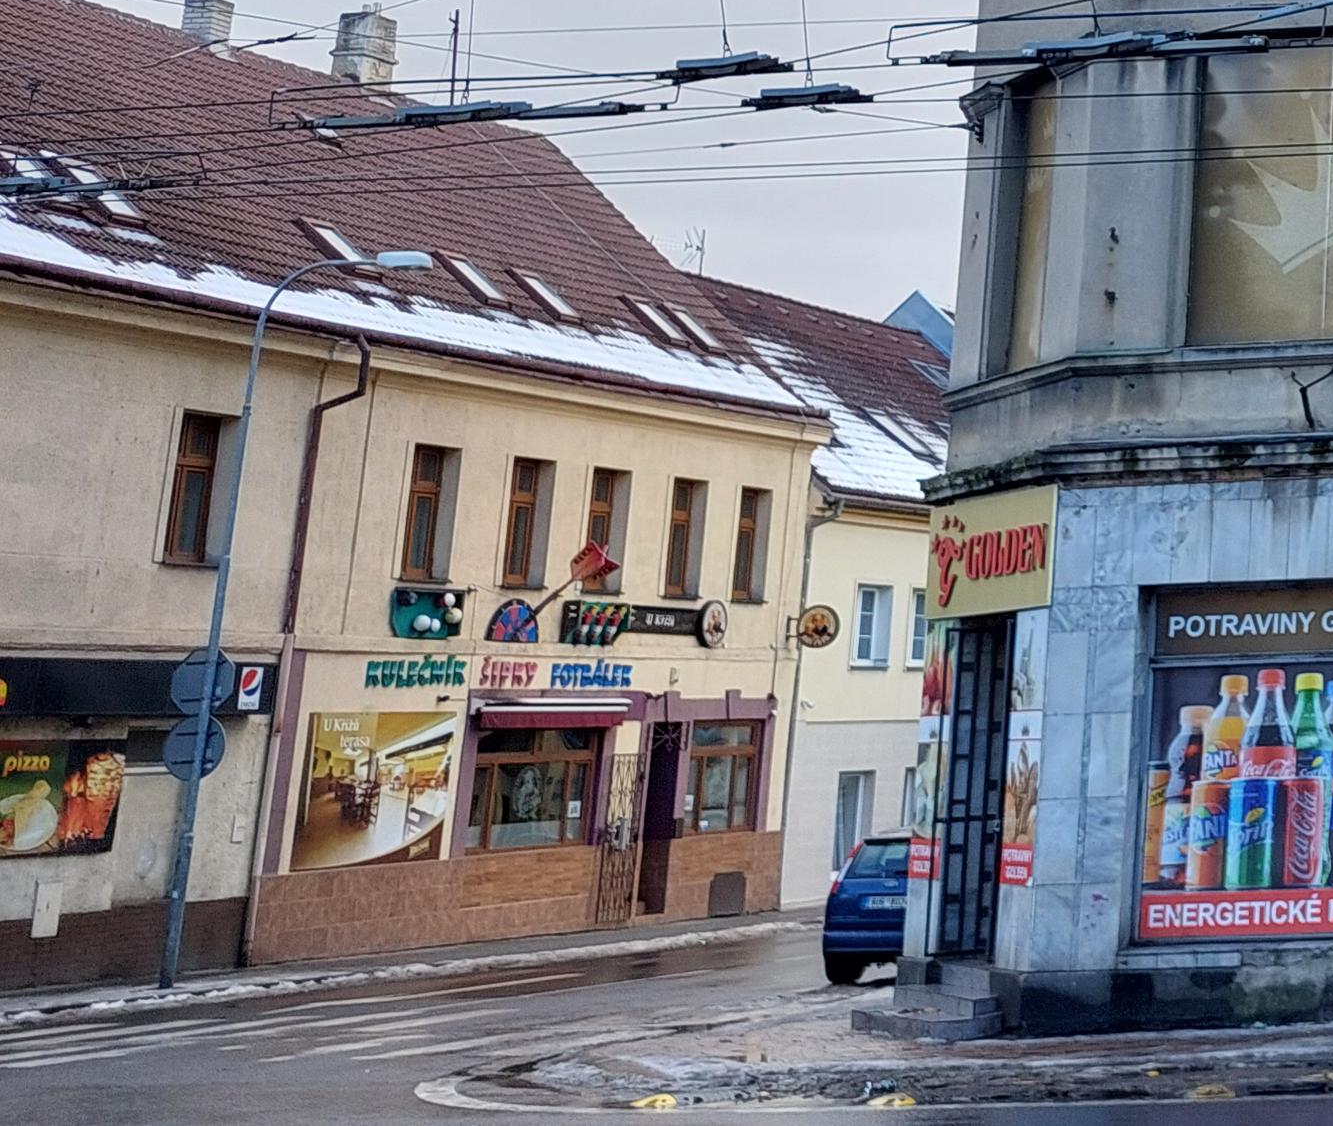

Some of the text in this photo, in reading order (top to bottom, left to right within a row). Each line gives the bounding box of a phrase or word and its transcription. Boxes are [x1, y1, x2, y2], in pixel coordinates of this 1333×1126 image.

[1167, 610, 1316, 639] POTRAVINY
[364, 653, 633, 689] KULEČNÍK ŠIPKY FOTBÁLEK
[3, 750, 51, 774] pizza
[1148, 893, 1323, 930] ENERGETICKÉ
